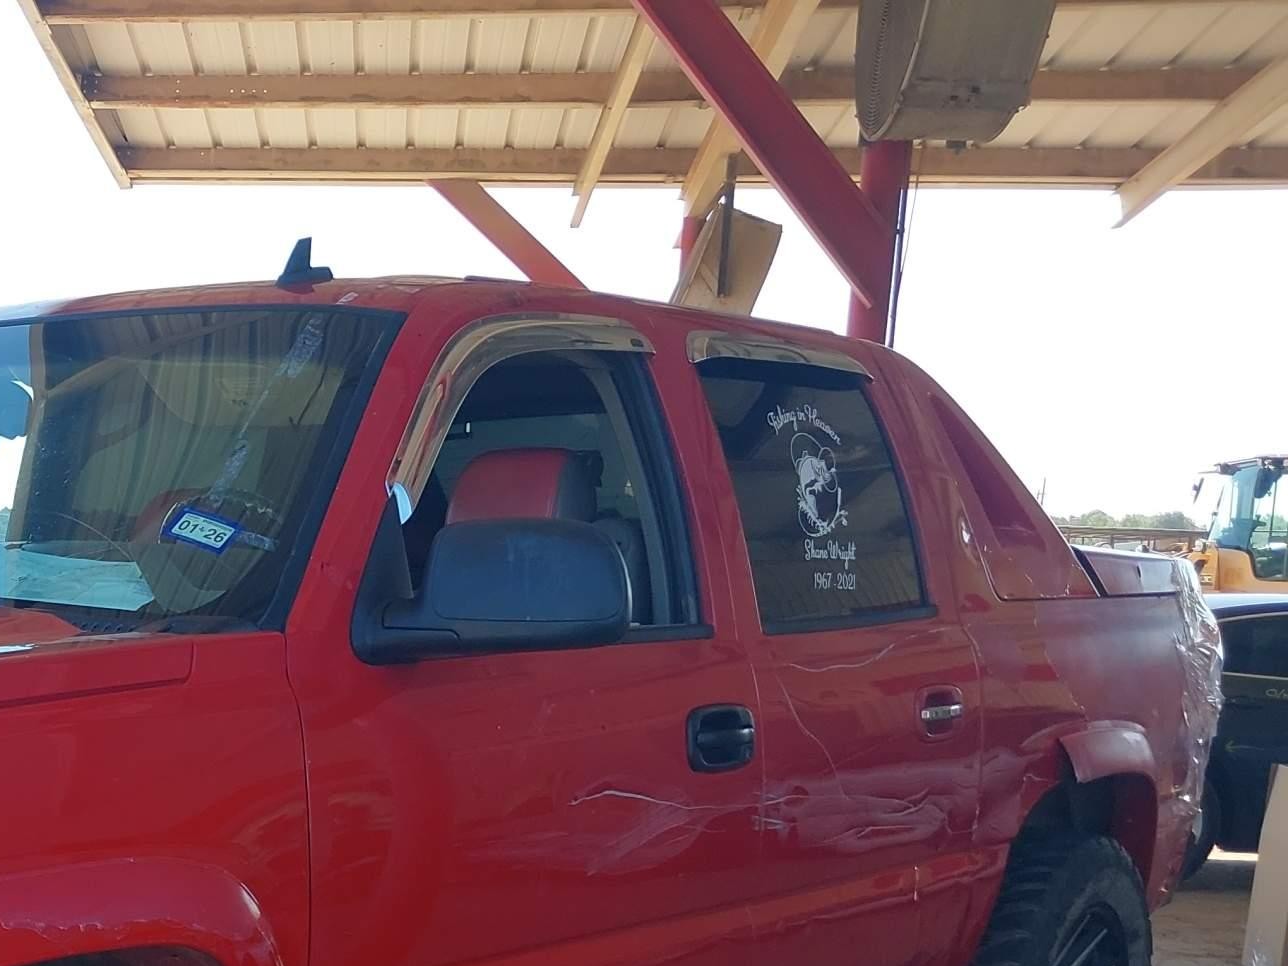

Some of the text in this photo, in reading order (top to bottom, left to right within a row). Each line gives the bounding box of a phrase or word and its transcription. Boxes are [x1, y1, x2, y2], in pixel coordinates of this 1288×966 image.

[767, 404, 842, 446] Fishing in Heaven
[178, 519, 200, 534] 01
[203, 528, 228, 544] 26
[804, 539, 857, 570] Shane Wright
[814, 572, 832, 590] 1967
[836, 571, 856, 590] 2021
